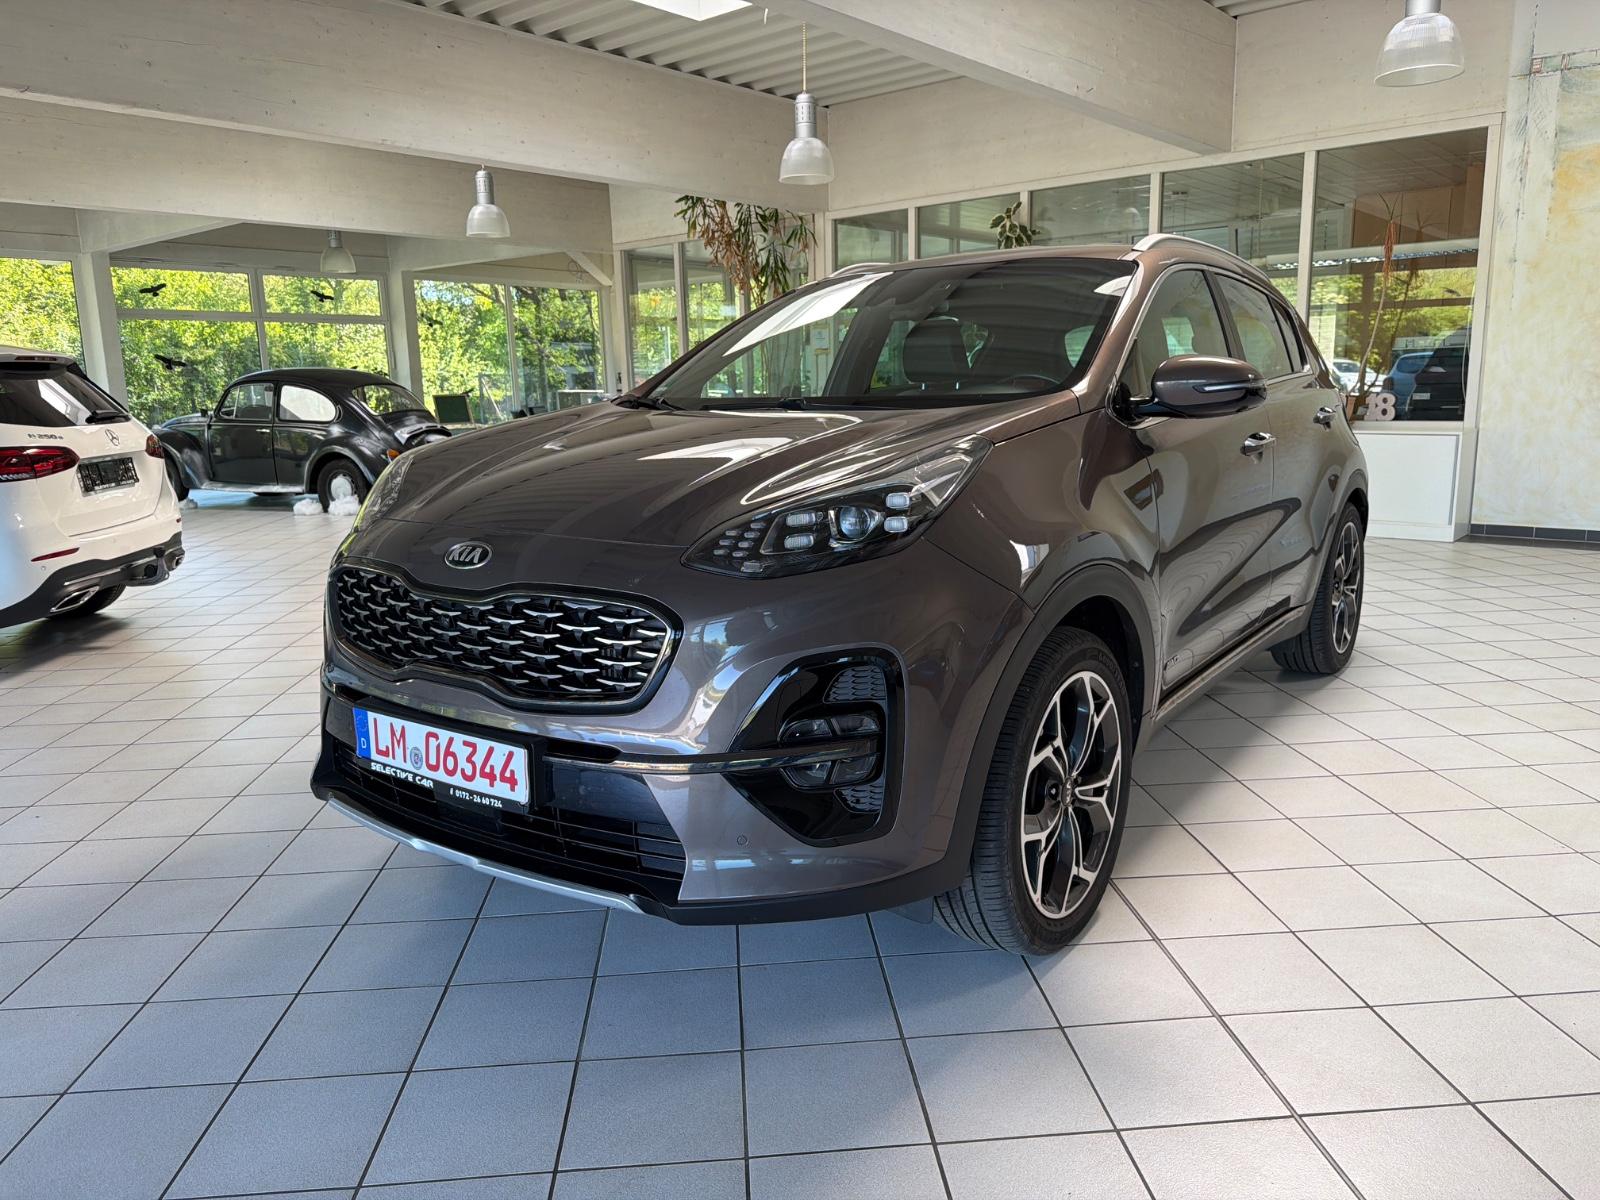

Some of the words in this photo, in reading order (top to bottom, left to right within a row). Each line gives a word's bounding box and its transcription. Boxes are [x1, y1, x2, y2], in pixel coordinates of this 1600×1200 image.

[448, 546, 483, 564] KIA
[361, 737, 367, 749] D
[373, 717, 407, 764] LM
[424, 731, 518, 792] 06344
[370, 762, 414, 783] SELECTIVE
[415, 776, 434, 789] CAR
